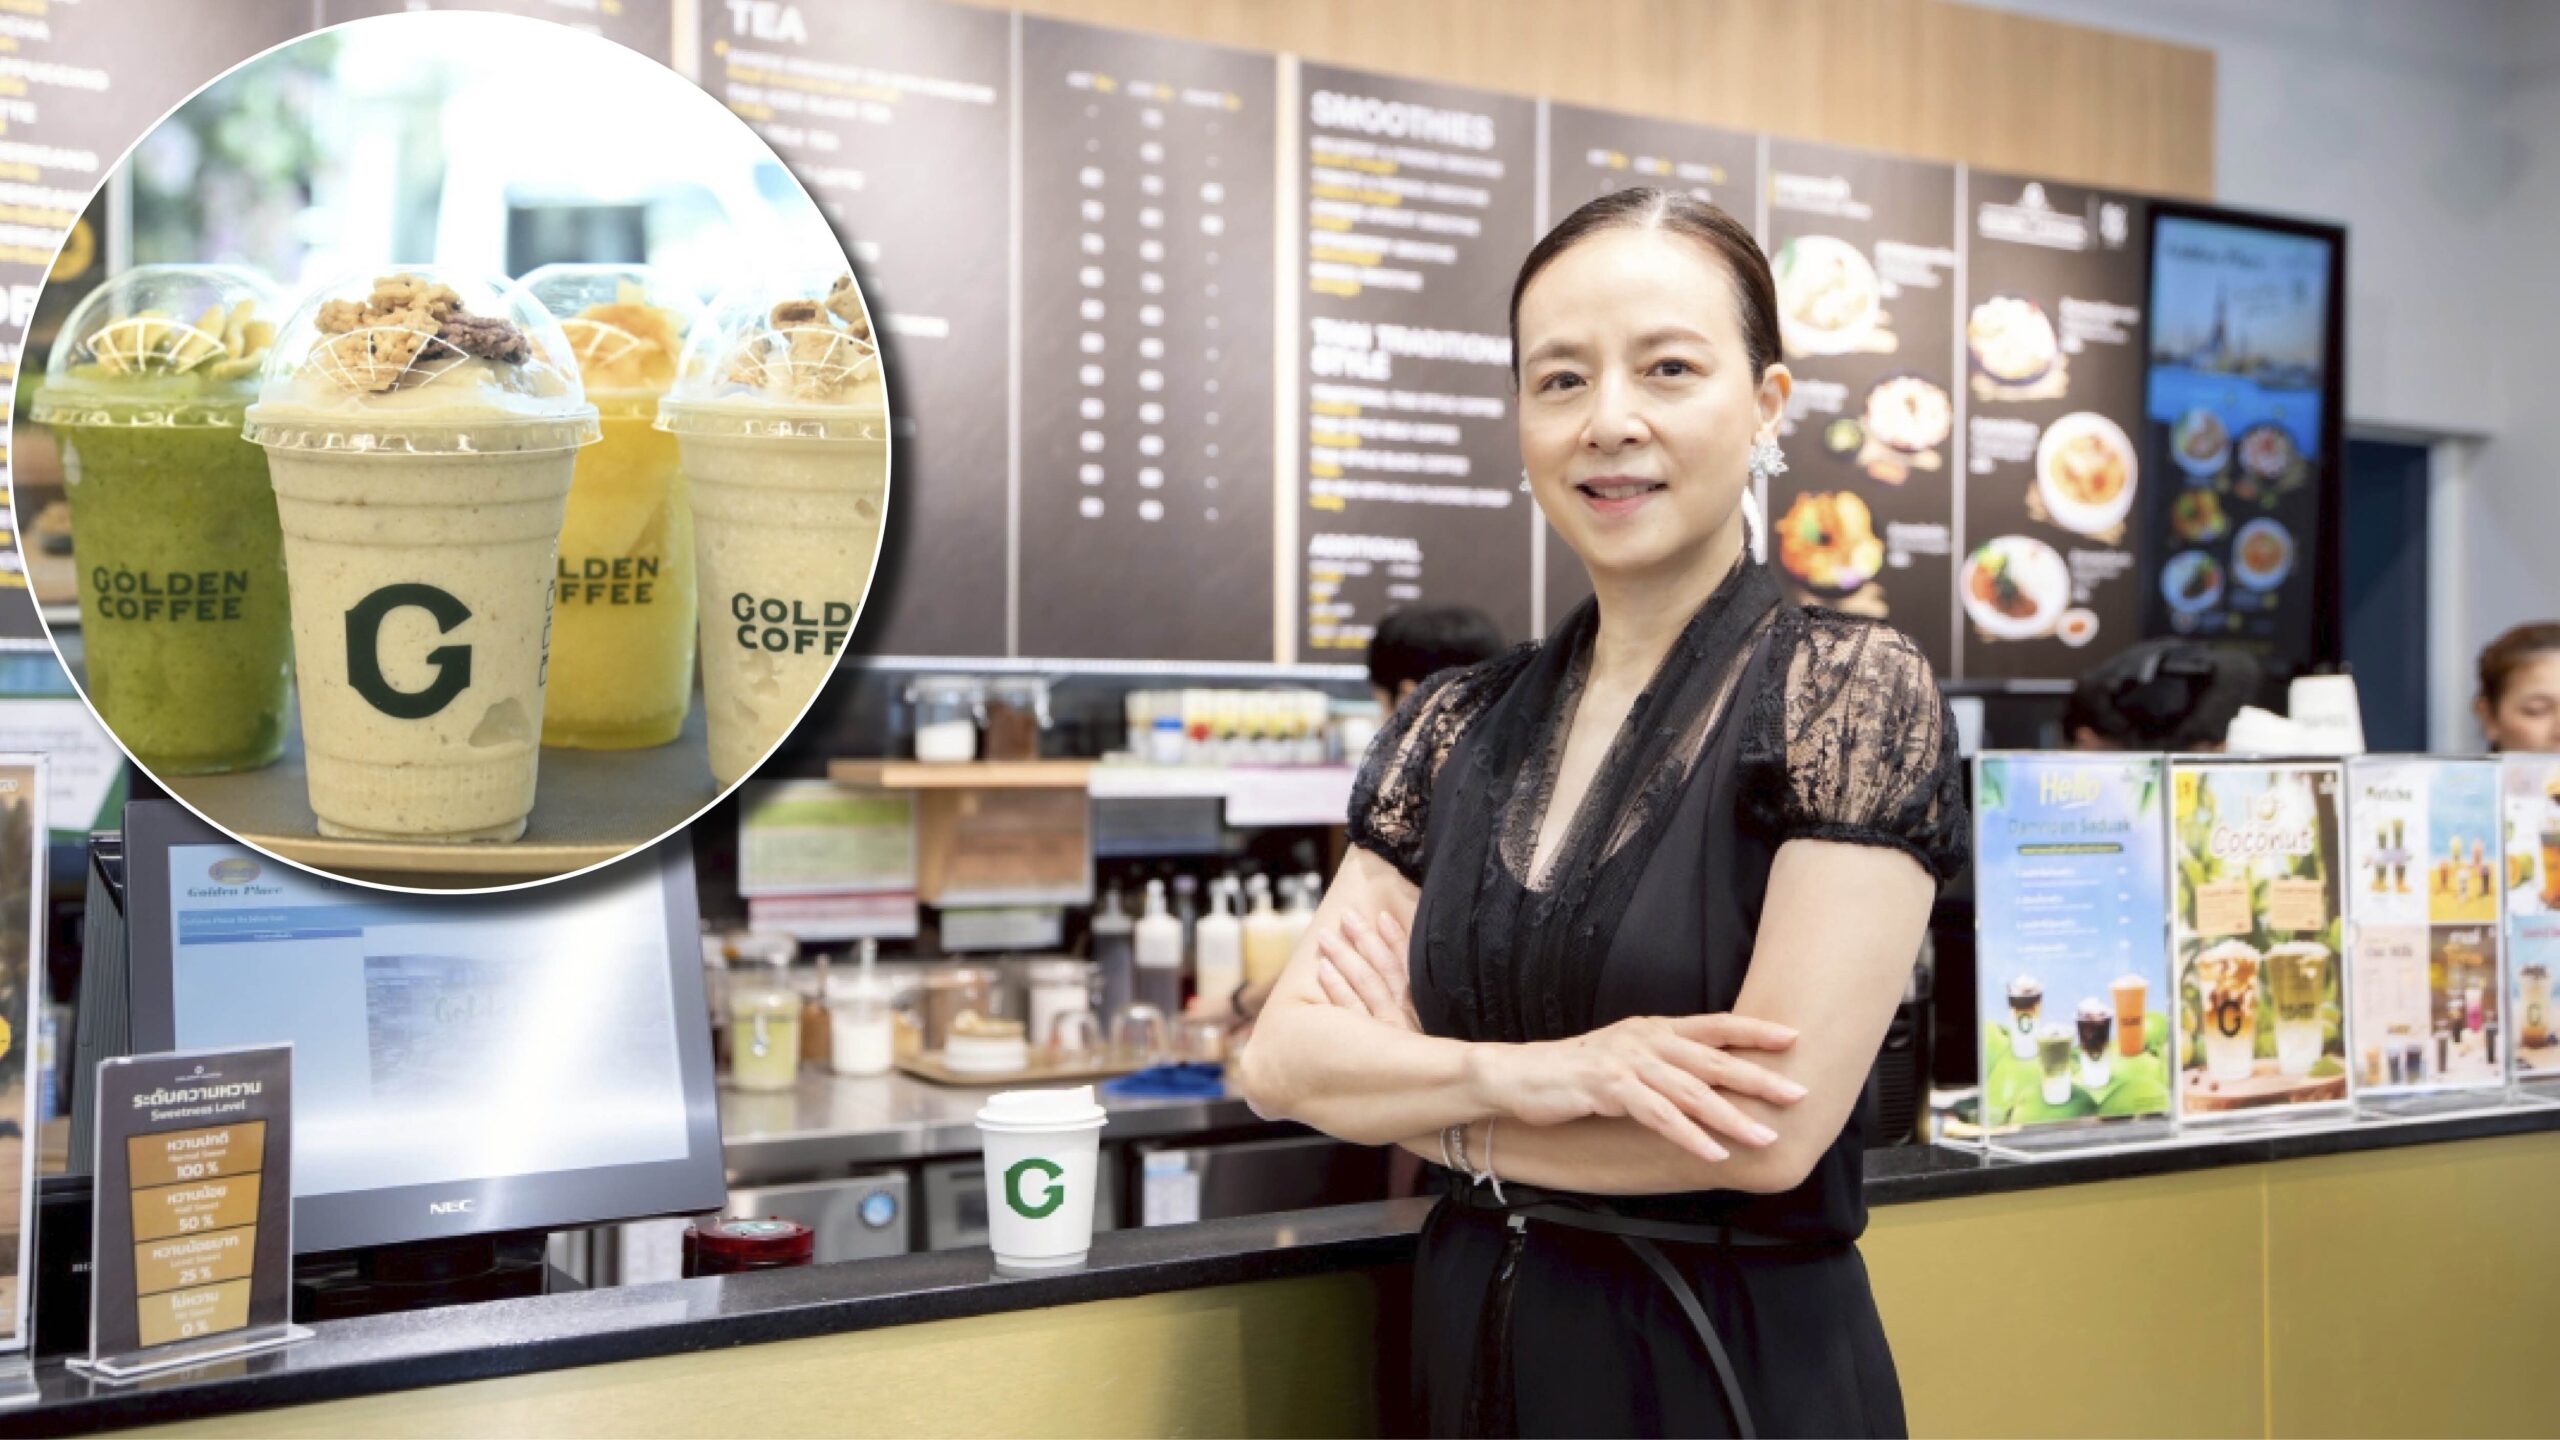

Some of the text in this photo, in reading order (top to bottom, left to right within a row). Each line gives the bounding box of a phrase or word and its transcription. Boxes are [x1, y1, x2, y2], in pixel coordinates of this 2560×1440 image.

[727, 1, 806, 44] TEA
[1310, 90, 1496, 150] SMOOTHIES
[92, 565, 248, 596] GOLDEN
[557, 555, 659, 580] LDEN
[97, 595, 242, 622] COFFEE
[732, 592, 860, 627] GOLD
[344, 583, 473, 719] G
[2038, 768, 2100, 806] Hello
[2211, 824, 2312, 856] Coconut
[151, 1099, 245, 1121] Sweetness Level
[177, 1161, 218, 1178] 100 %
[1005, 1158, 1064, 1219] G
[180, 1214, 214, 1231] 50 %
[430, 1199, 474, 1216] NEC
[180, 1269, 197, 1284] 25
